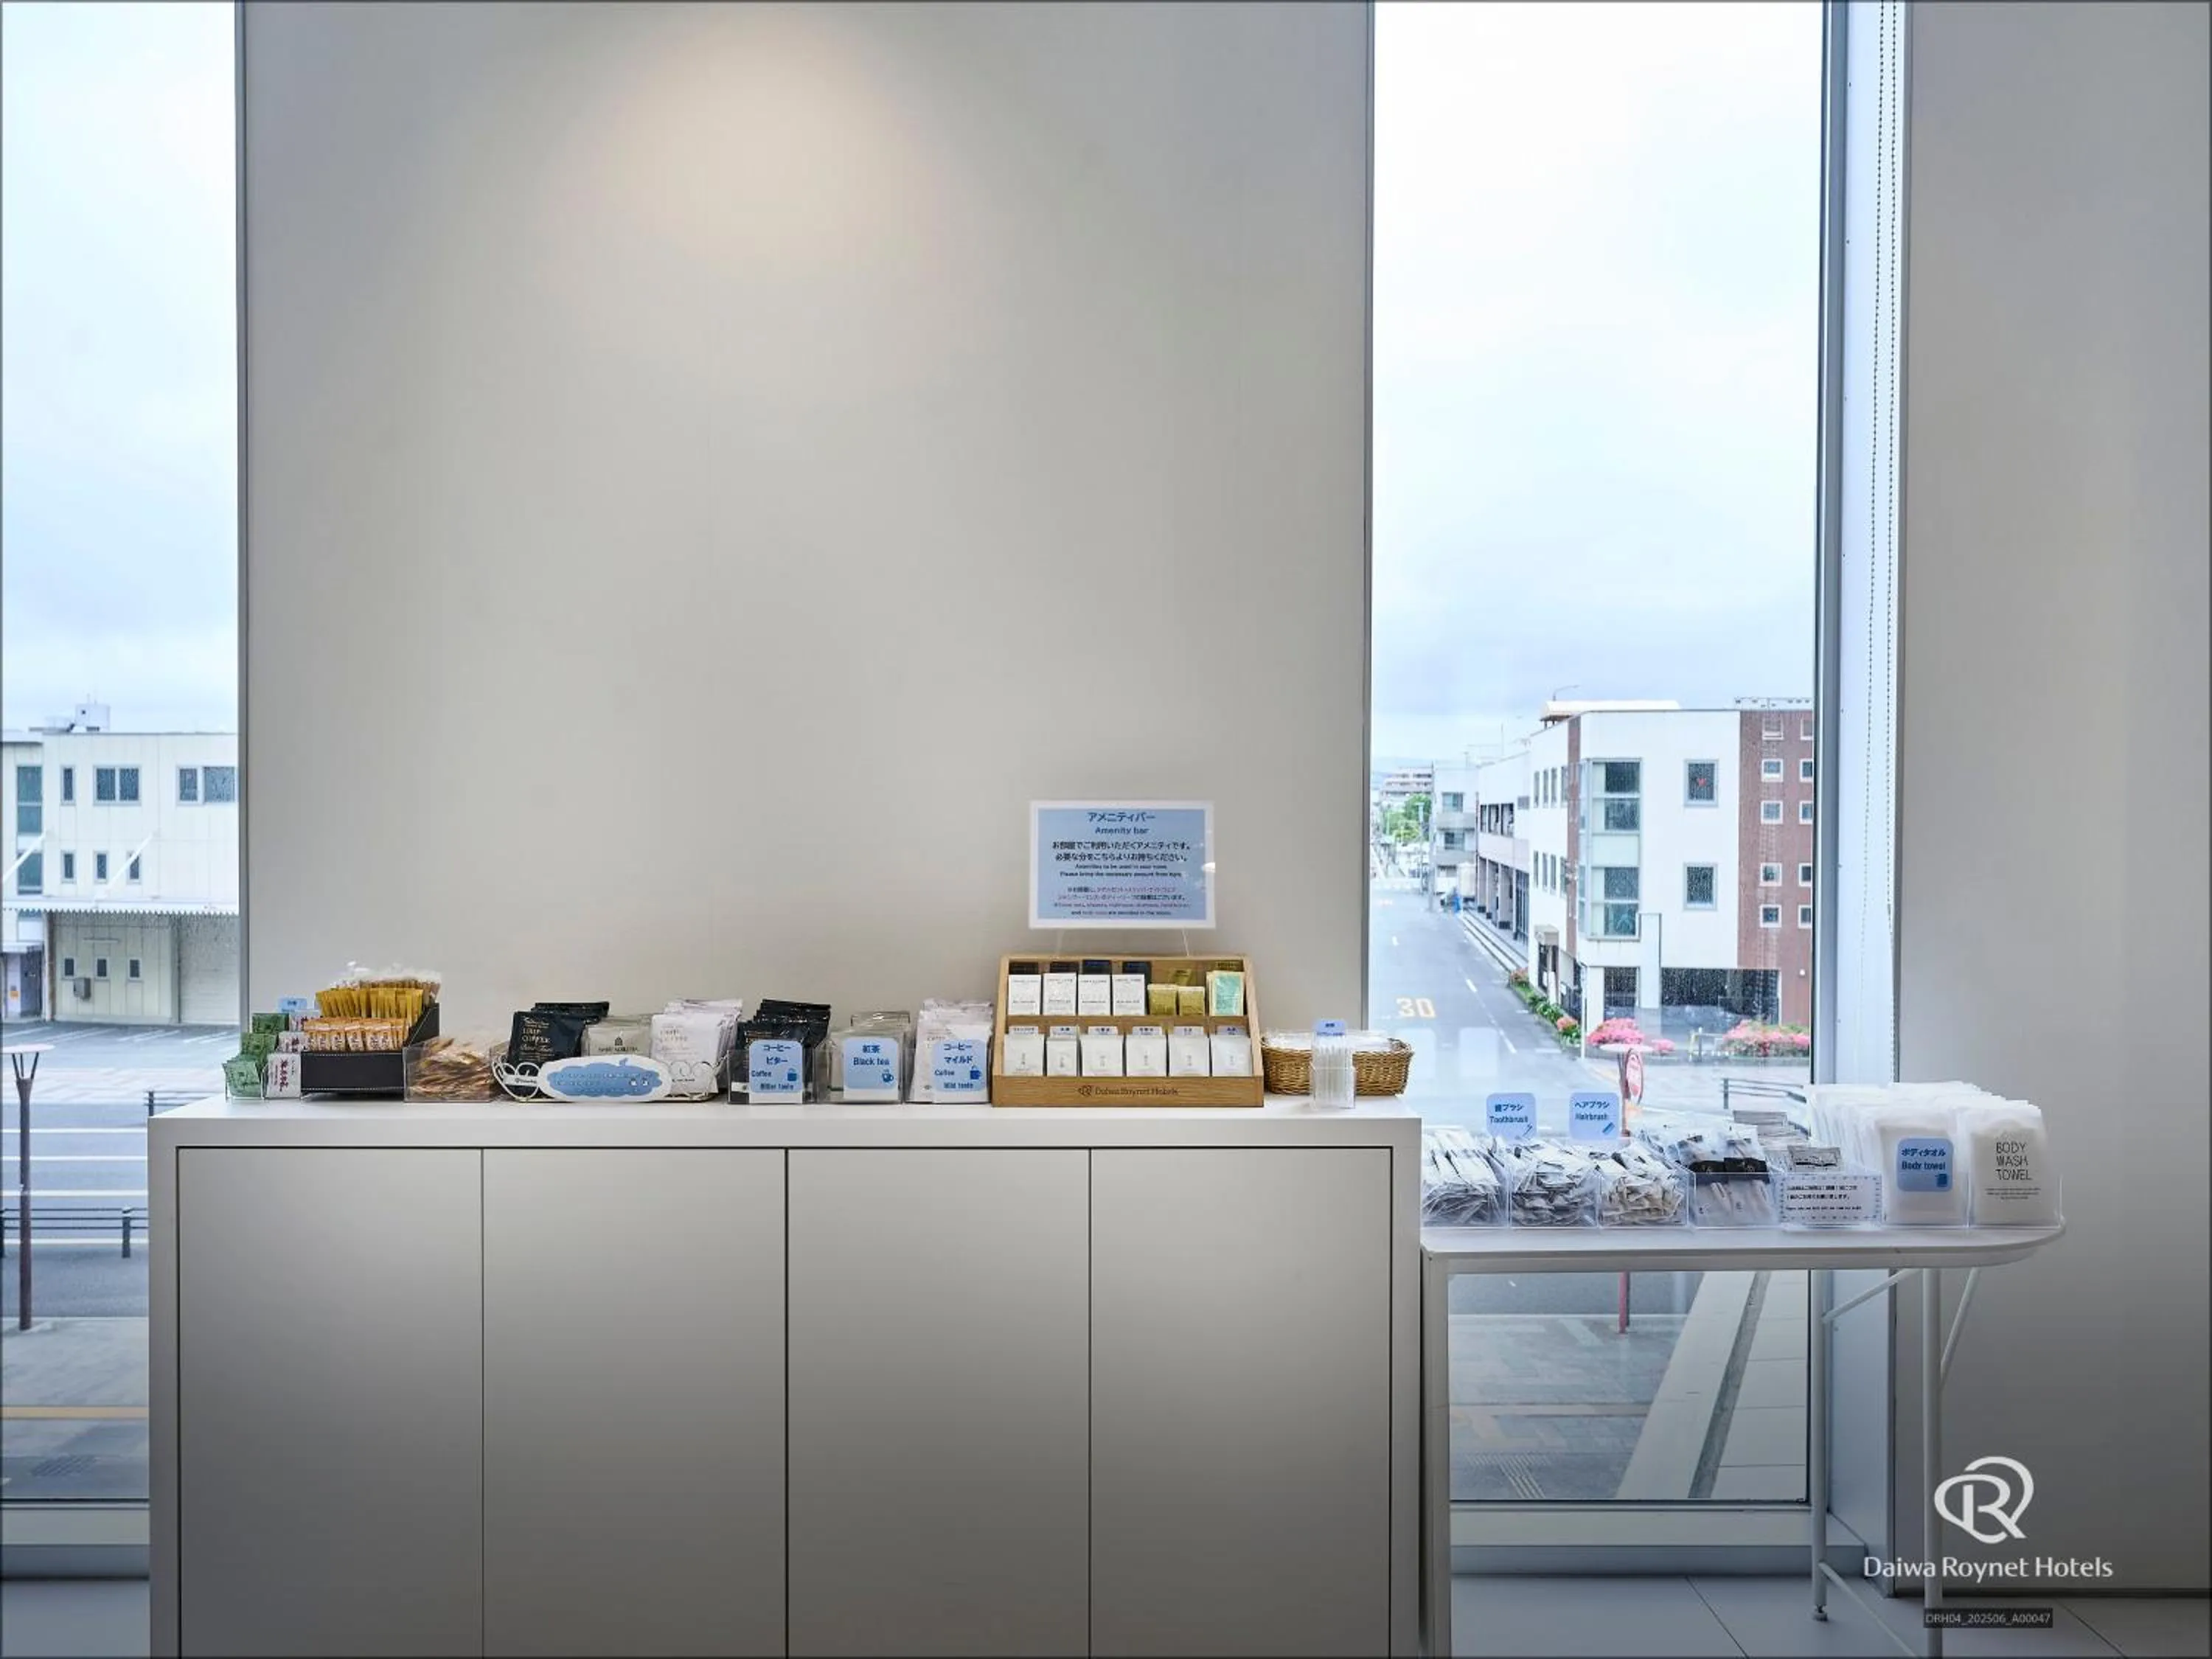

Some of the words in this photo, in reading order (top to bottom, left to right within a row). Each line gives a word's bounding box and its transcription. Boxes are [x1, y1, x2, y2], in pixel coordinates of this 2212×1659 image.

[1088, 813, 1156, 822] アメニティバー
[1095, 827, 1131, 835] Amenity
[1397, 998, 1436, 1018] 30
[763, 1044, 791, 1052] コーヒー
[862, 1044, 880, 1054] 紅茶
[944, 1043, 973, 1051] コーヒー
[766, 1057, 788, 1065] ビター
[853, 1057, 875, 1066] Black
[877, 1057, 890, 1065] tea
[944, 1056, 973, 1064] マイルド
[934, 1068, 955, 1077] Coffee
[1495, 1104, 1524, 1113] 歯ブラシ
[1574, 1101, 1610, 1110] ヘアブラシ
[1489, 1116, 1528, 1124] Toothbrush
[1575, 1113, 1609, 1121] Hairbrush
[1996, 1141, 2027, 1154] BODY
[1902, 1148, 1947, 1157] ボディタオル
[1996, 1155, 2029, 1167] WASH
[1902, 1161, 1923, 1172] Body
[1924, 1161, 1947, 1170] towel
[1995, 1169, 2033, 1180] TOWEL
